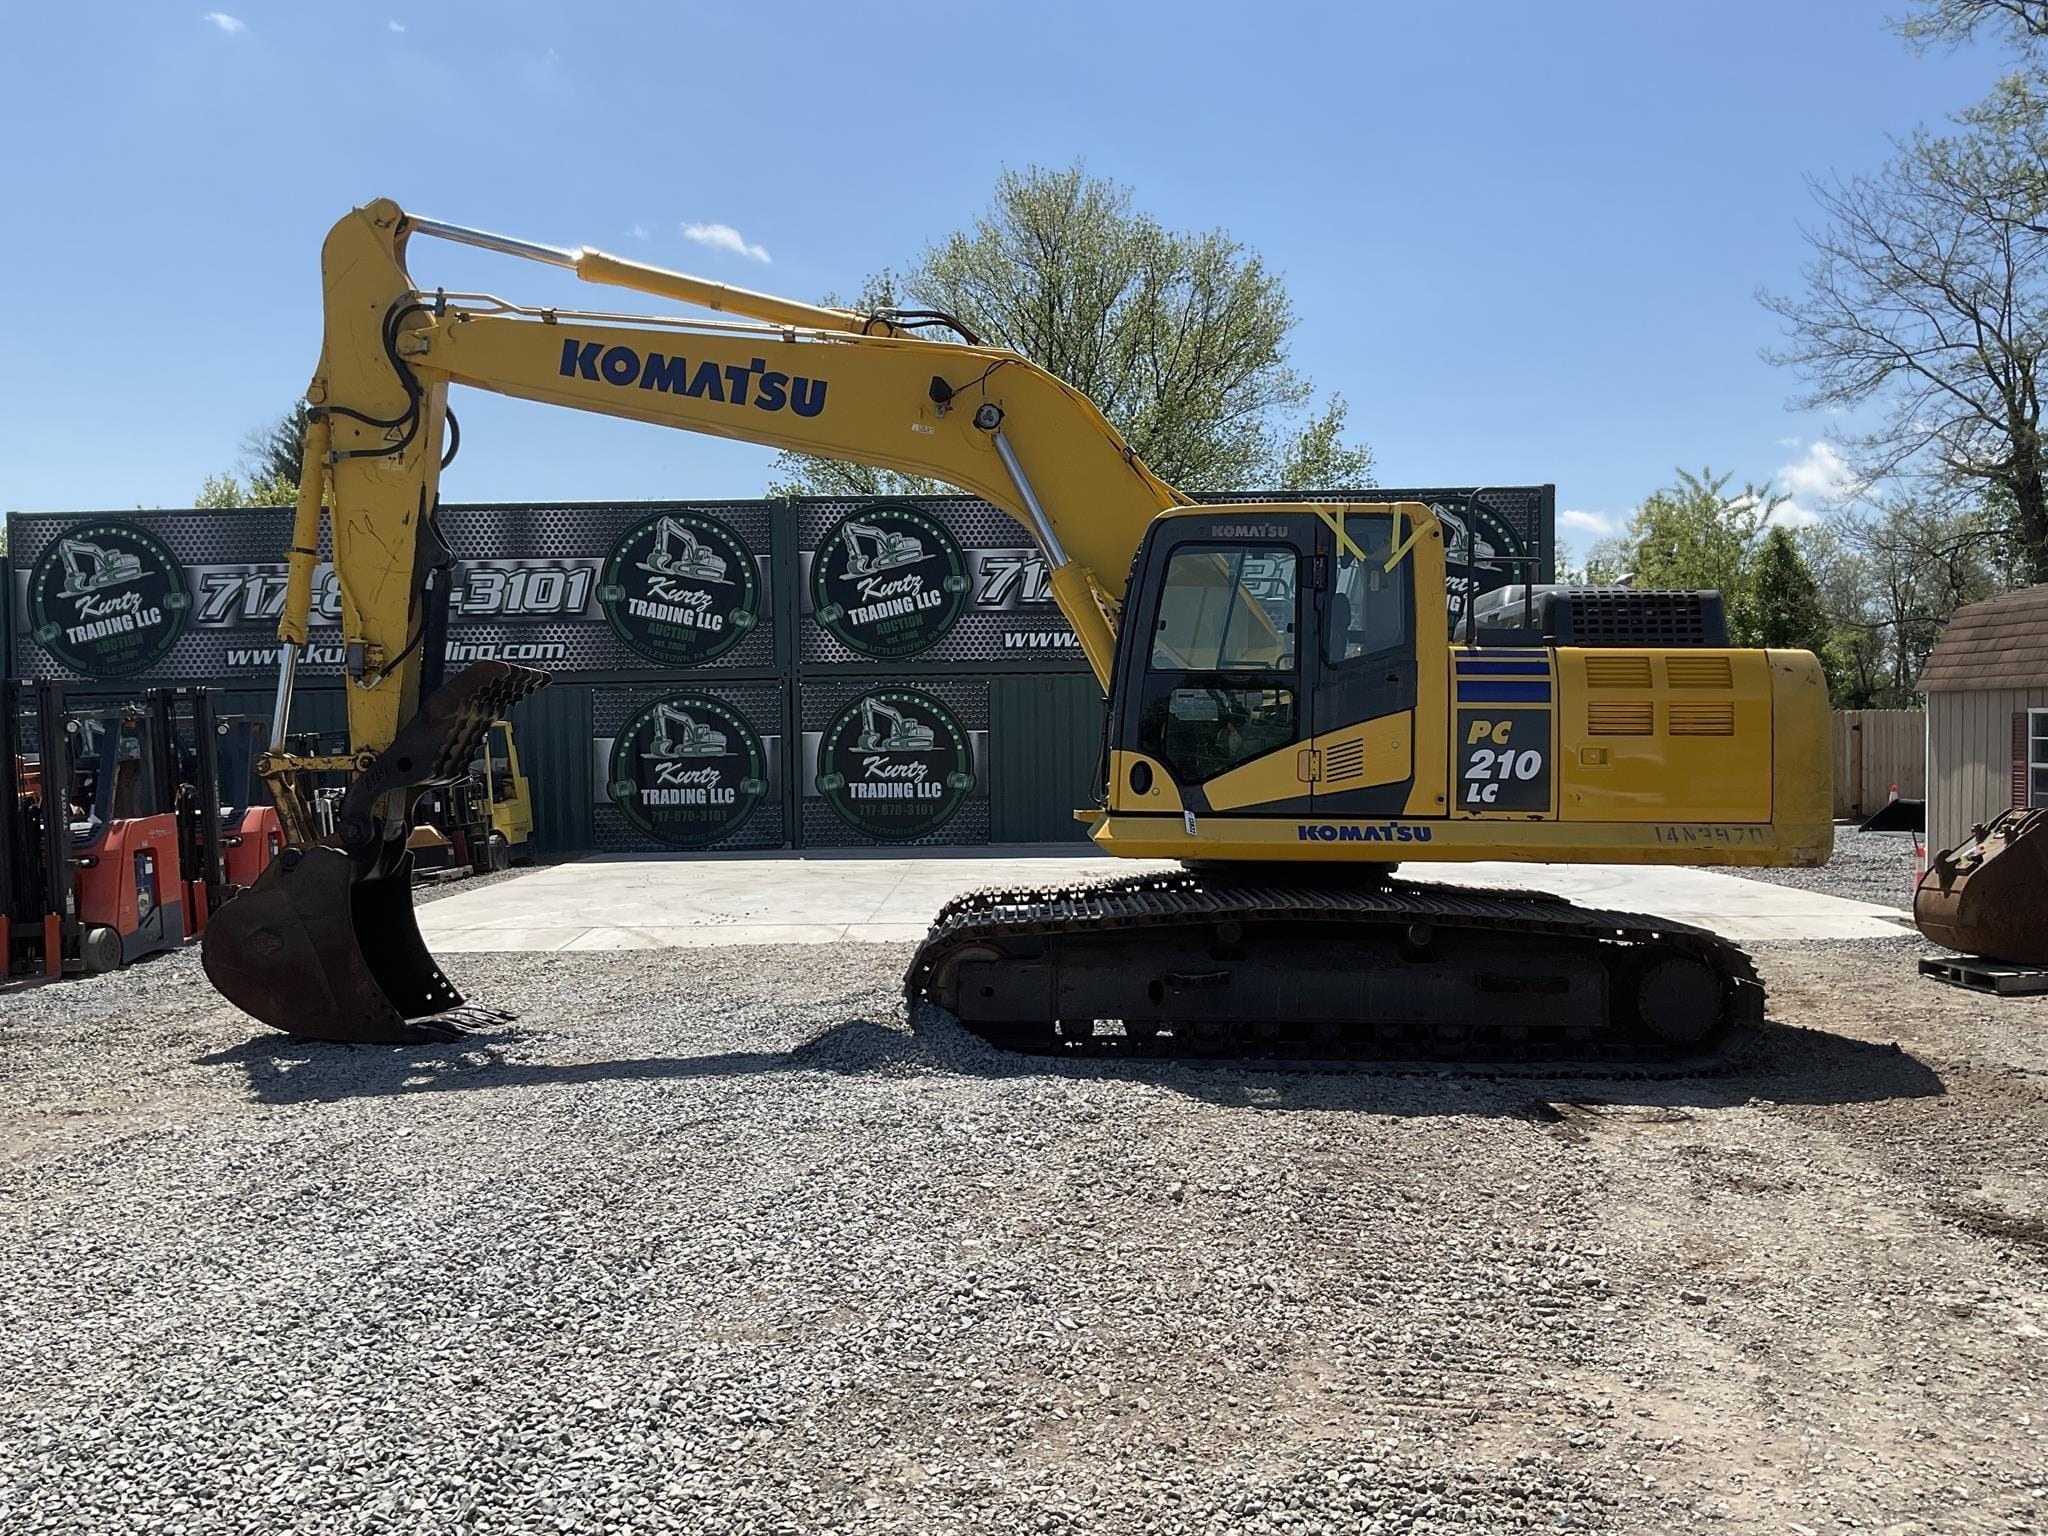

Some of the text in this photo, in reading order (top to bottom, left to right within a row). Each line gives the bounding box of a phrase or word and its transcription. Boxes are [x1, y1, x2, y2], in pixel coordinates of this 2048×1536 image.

[560, 338, 828, 417] KOMATSU
[1212, 523, 1288, 538] KOMATSU
[647, 576, 713, 612] Kurtz
[857, 573, 924, 602] Kurtz
[75, 591, 143, 620] Kurtz
[628, 598, 723, 631] TRADING LLC
[848, 589, 942, 625] TRADING LLC
[66, 607, 162, 644] TRADING LLC
[648, 622, 697, 642] AUCTION
[876, 614, 924, 635] AUCTION
[1467, 720, 1512, 744] PC
[655, 762, 721, 789] Kurtz
[862, 756, 928, 783] Kurtz
[1465, 749, 1542, 780] 210
[641, 787, 735, 805] TRADING LLC
[849, 781, 942, 798] TRADING LLC
[1466, 783, 1499, 803] LC
[859, 803, 934, 816] 717-870-3101
[1298, 822, 1432, 842] KOMATSU
